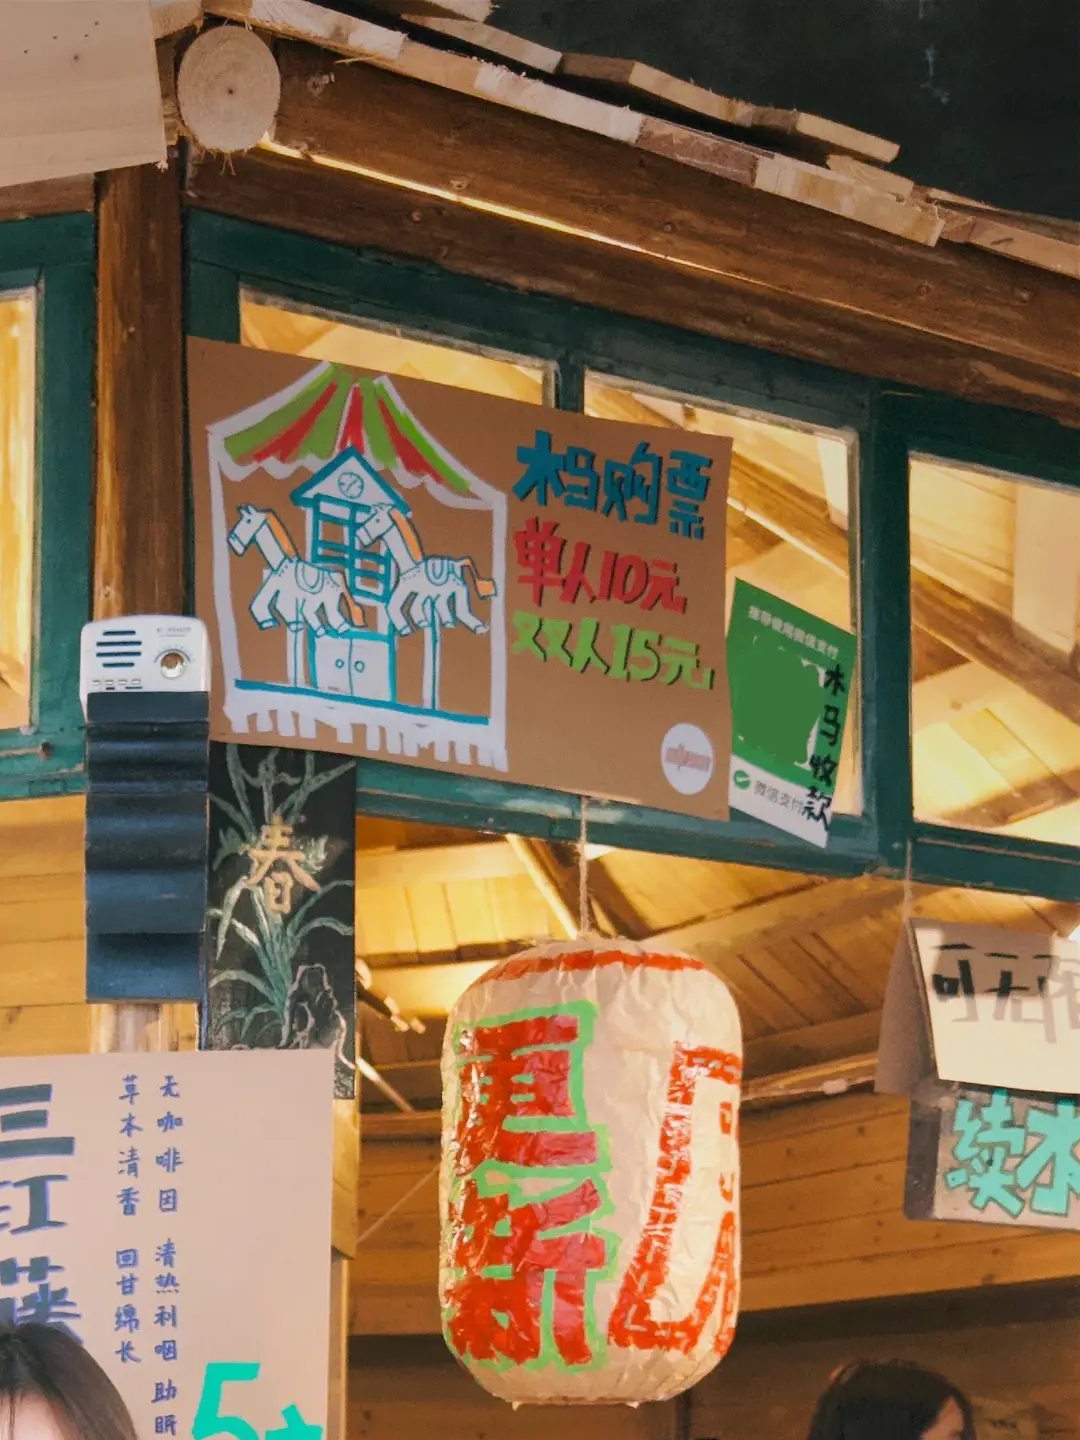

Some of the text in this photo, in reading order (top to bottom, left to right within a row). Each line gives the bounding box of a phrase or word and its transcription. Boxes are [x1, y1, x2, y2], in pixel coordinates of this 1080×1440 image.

[512, 429, 713, 540] 木马购票
[513, 515, 688, 614] 单人10元
[512, 609, 716, 690] 双人15元
[802, 664, 846, 832] 木马收款
[154, 1075, 184, 1214] 无咖啡因
[114, 1074, 145, 1365] 草本清香 回甘绵长
[152, 1237, 181, 1363] 清热利咽
[150, 1381, 178, 1438] 助眠
